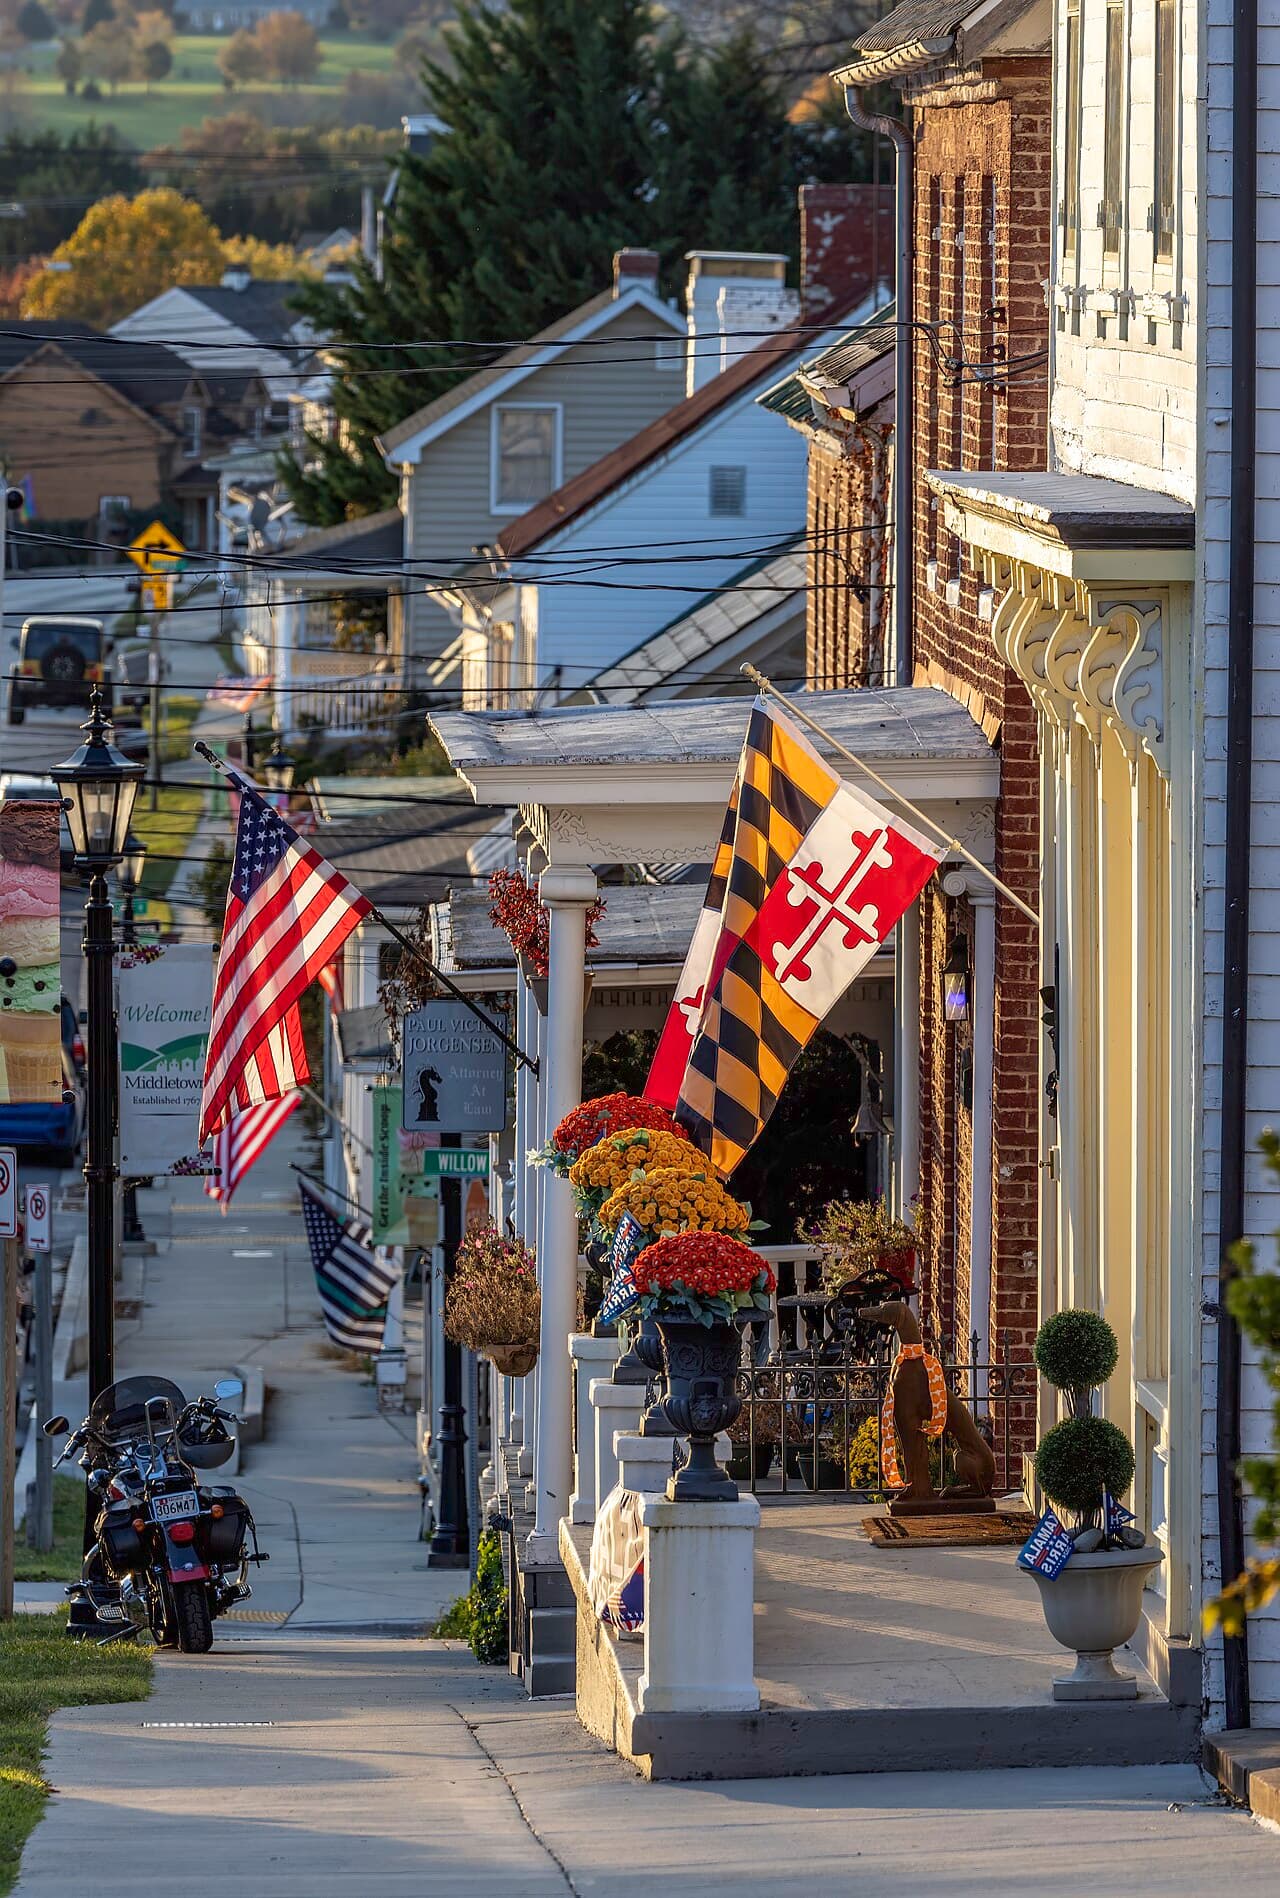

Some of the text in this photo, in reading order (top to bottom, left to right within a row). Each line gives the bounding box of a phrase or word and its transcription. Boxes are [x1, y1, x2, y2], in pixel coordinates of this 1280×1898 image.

[124, 1003, 209, 1023] Welcome!
[408, 1018, 447, 1032] PAUL
[407, 1037, 504, 1056] JORGENSEN
[448, 1065, 503, 1082] Attorney
[471, 1084, 486, 1097] At
[132, 1095, 181, 1105] Established
[438, 1153, 487, 1172] WILLOW
[156, 1499, 196, 1516] 306M47
